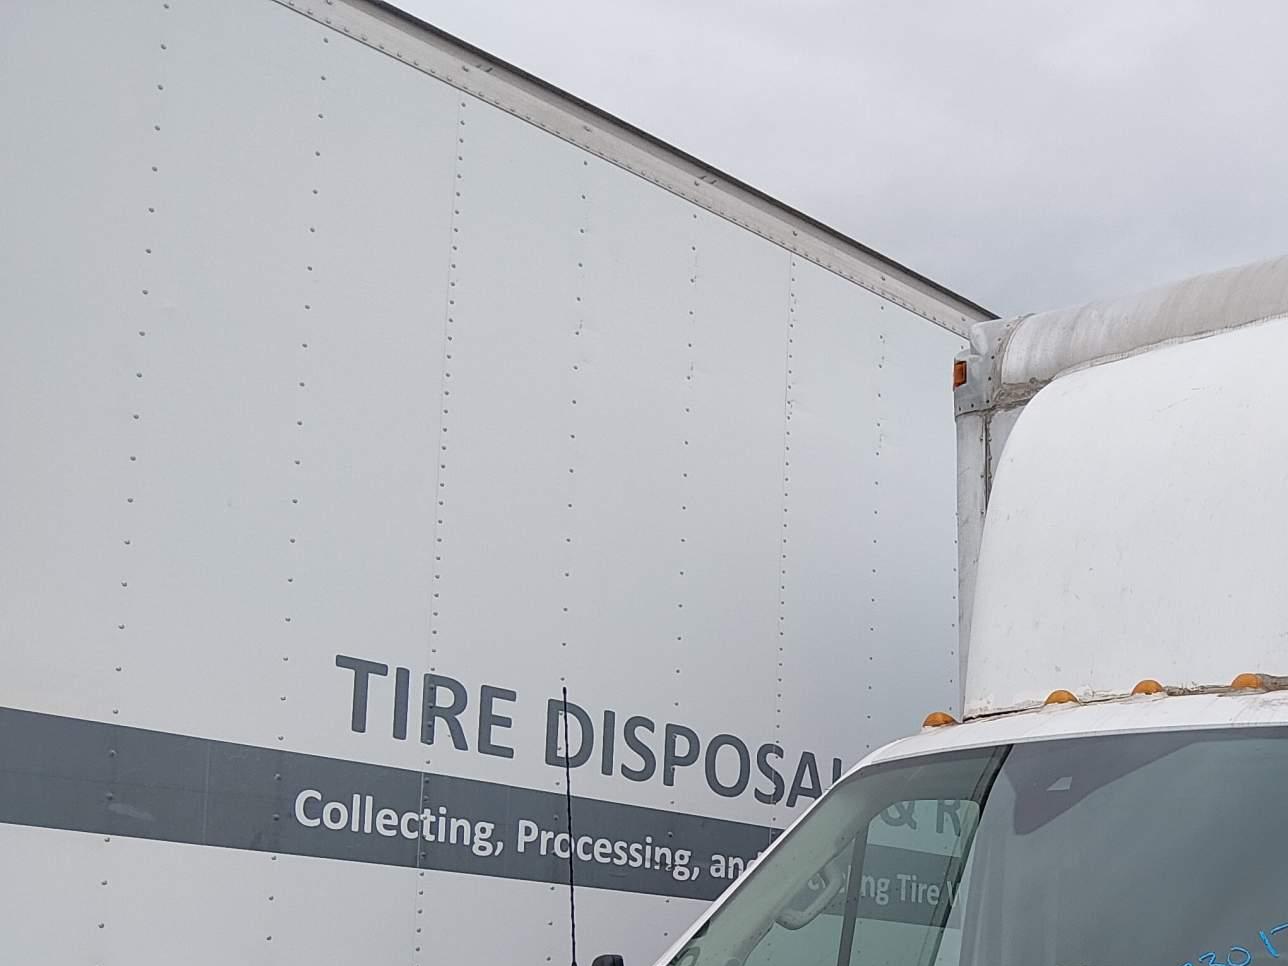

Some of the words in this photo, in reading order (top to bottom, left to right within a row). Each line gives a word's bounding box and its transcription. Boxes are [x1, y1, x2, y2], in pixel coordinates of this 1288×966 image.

[336, 655, 517, 759] TIRE
[294, 789, 504, 857] Collecting,
[517, 819, 700, 881] Processing,
